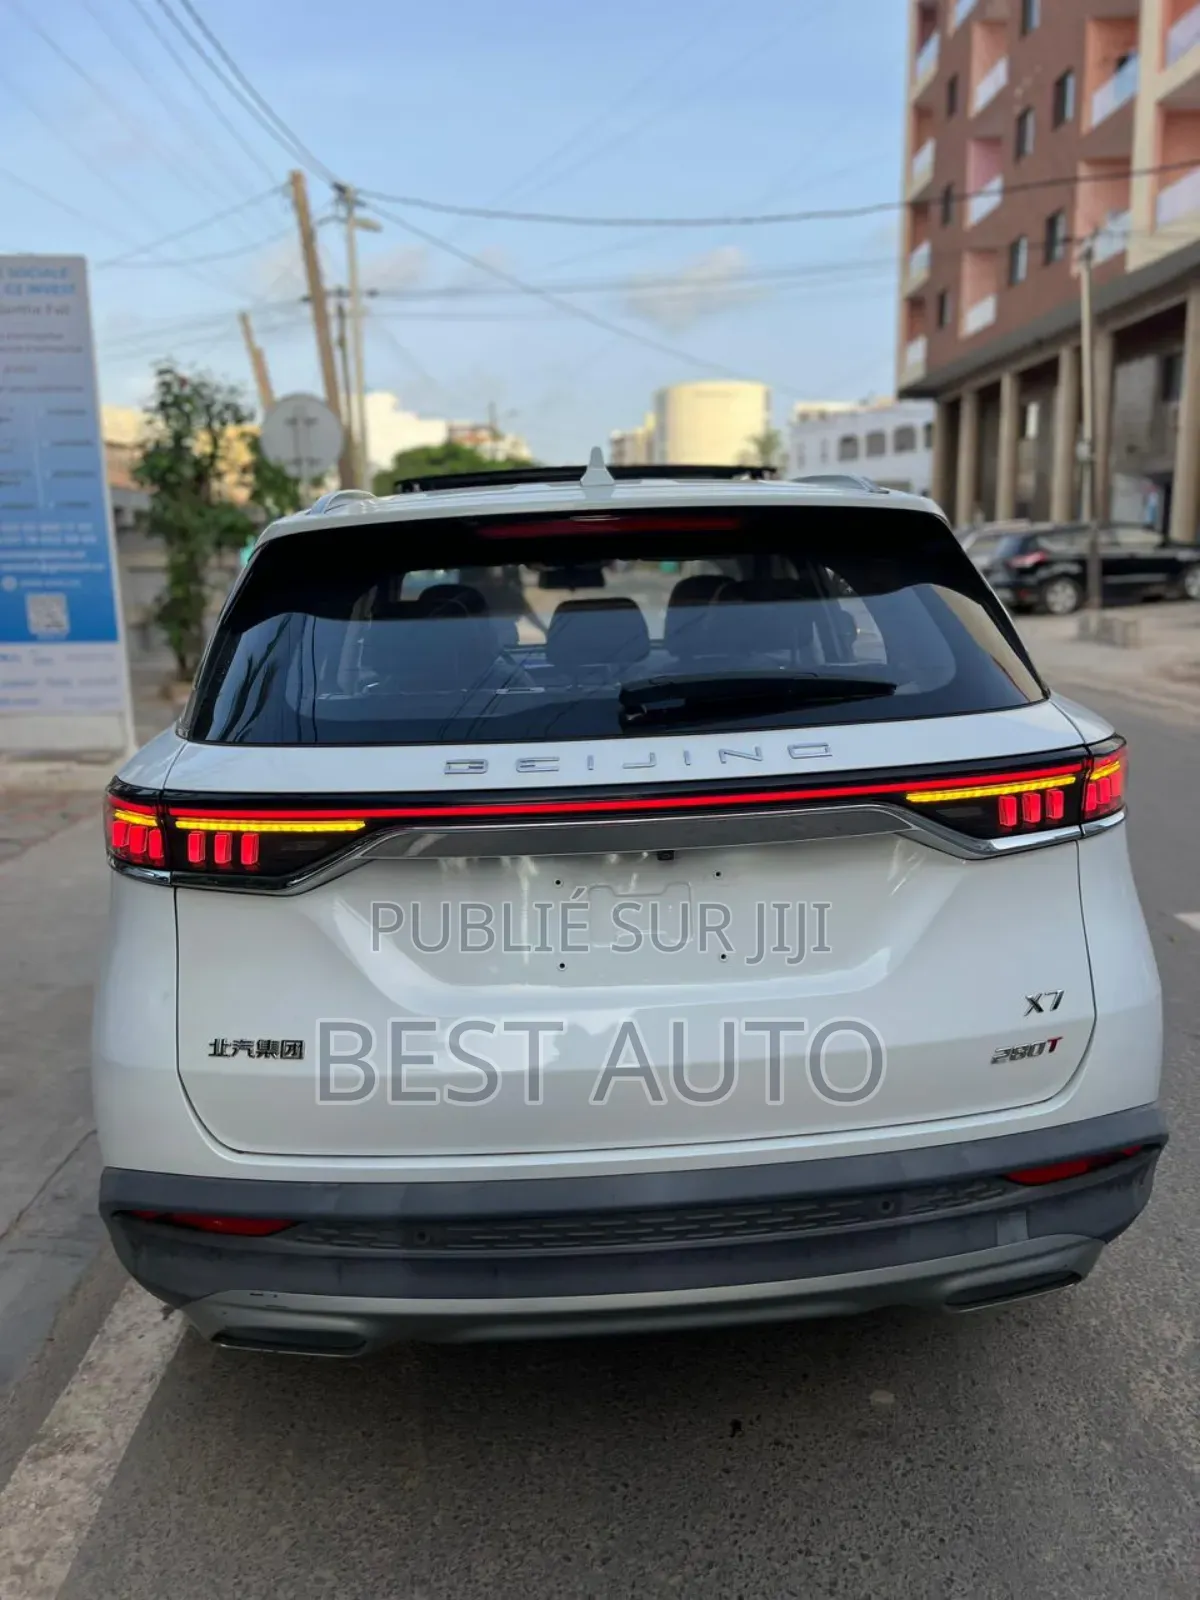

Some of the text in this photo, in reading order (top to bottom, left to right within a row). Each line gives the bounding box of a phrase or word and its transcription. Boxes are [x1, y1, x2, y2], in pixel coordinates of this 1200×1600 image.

[444, 742, 833, 775] BEIJING
[1024, 989, 1064, 1016] X7
[208, 1038, 305, 1060] 北汽集团
[990, 1036, 1063, 1064] 280T
